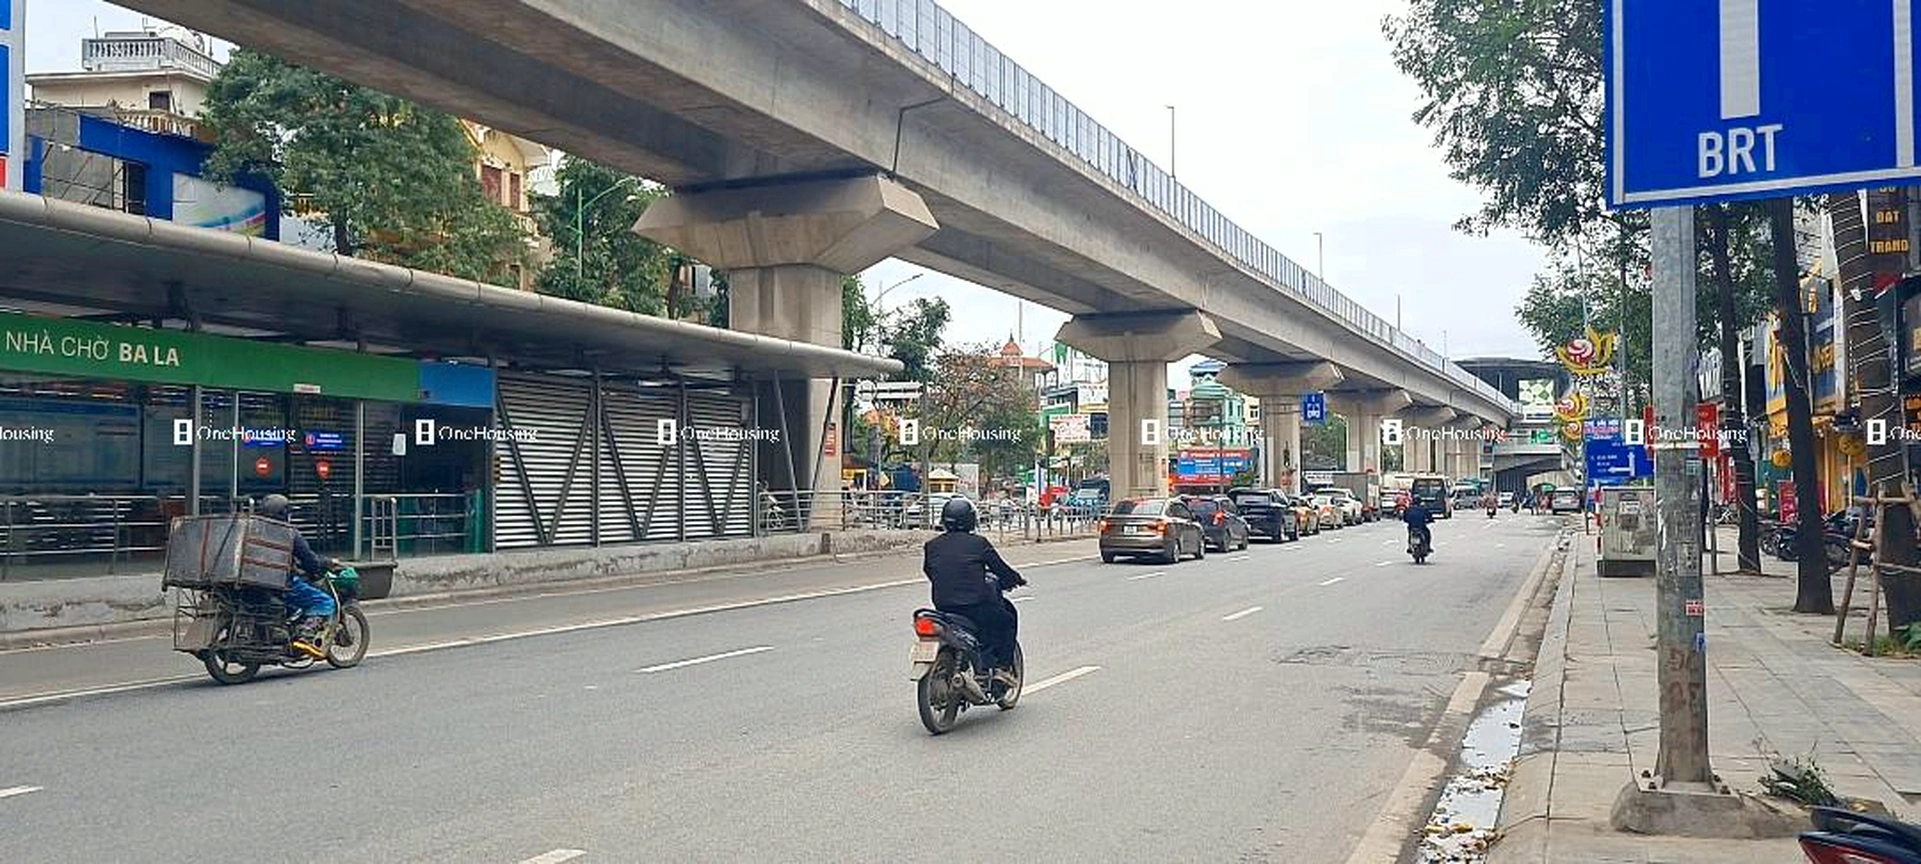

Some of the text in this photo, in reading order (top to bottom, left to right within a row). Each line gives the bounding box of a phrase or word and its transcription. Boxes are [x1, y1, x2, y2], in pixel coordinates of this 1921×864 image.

[1698, 123, 1783, 179] BRT
[6, 329, 180, 367] NHÀ CHỜ BA LA
